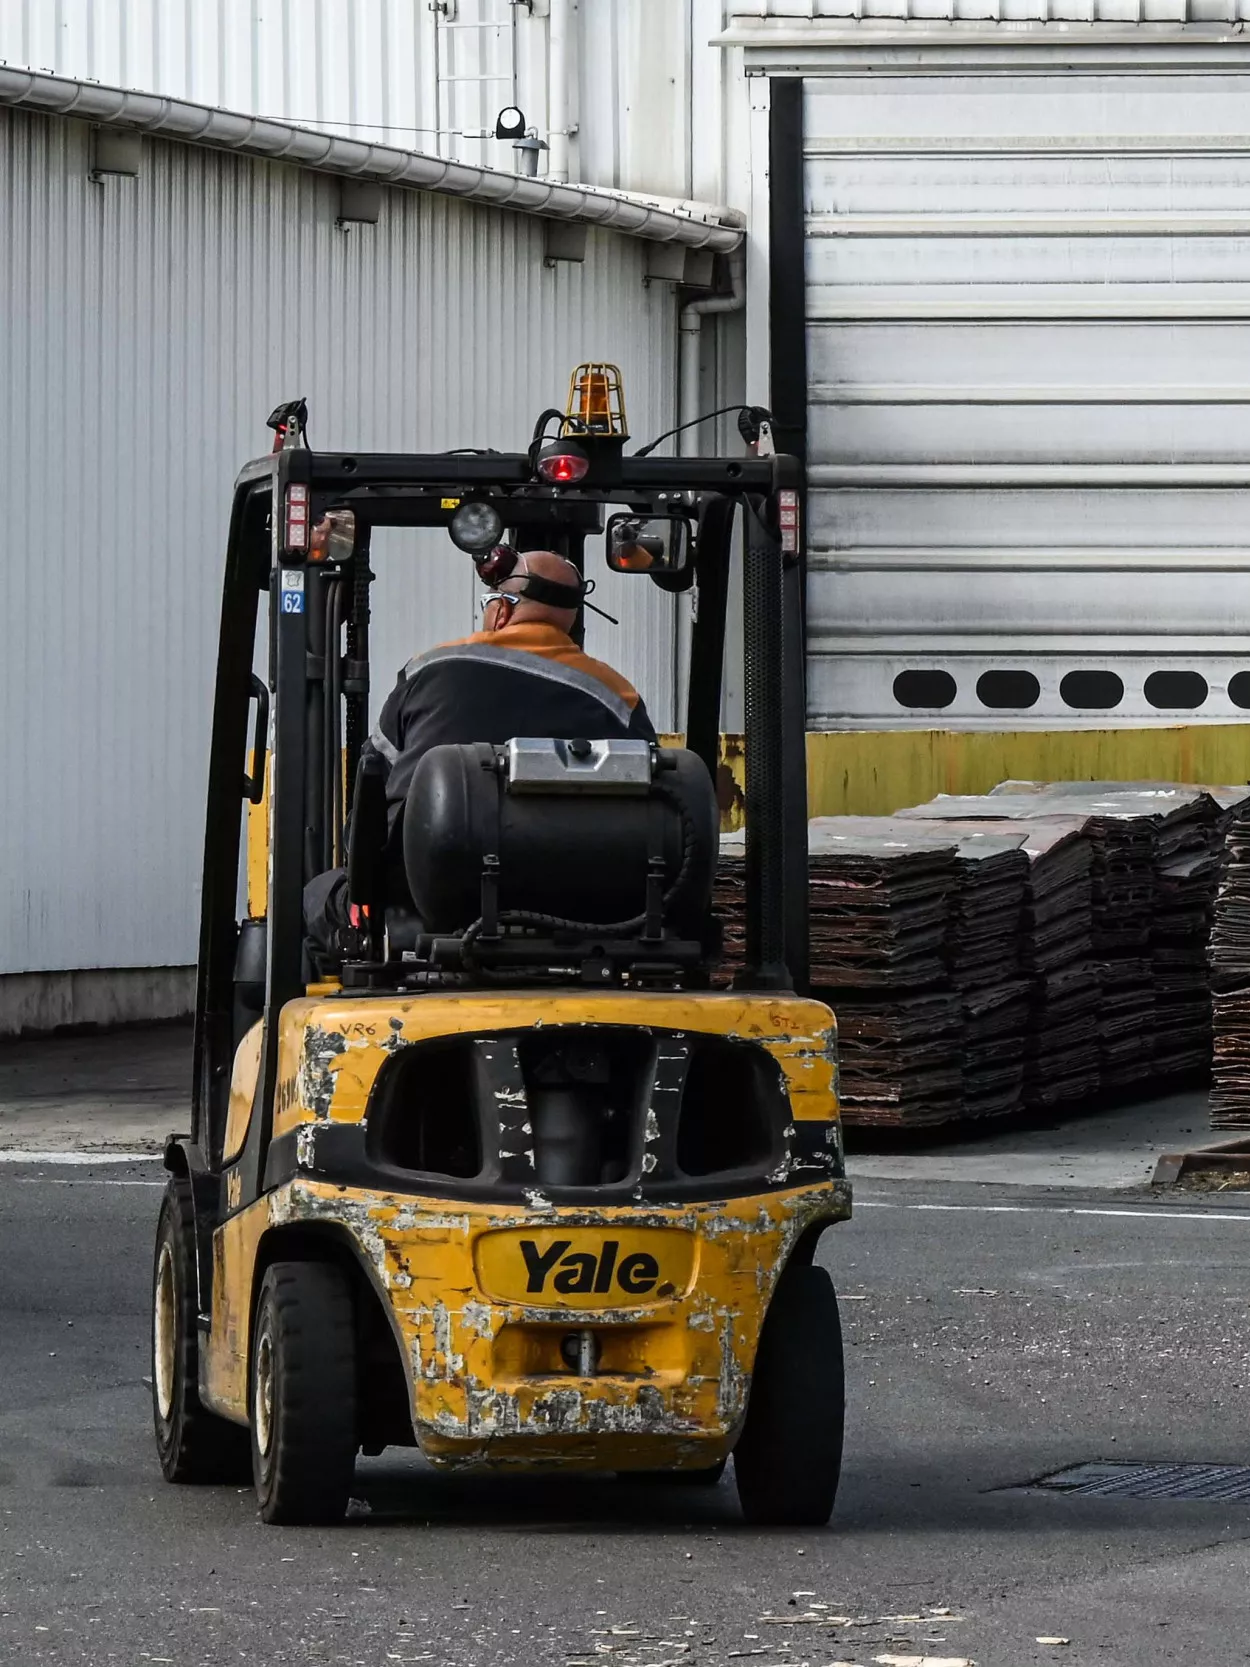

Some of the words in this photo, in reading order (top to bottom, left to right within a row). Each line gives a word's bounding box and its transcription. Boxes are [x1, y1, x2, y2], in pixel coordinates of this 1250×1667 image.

[284, 593, 302, 613] 62
[340, 1022, 377, 1036] VR6
[519, 1240, 659, 1295] Yale
